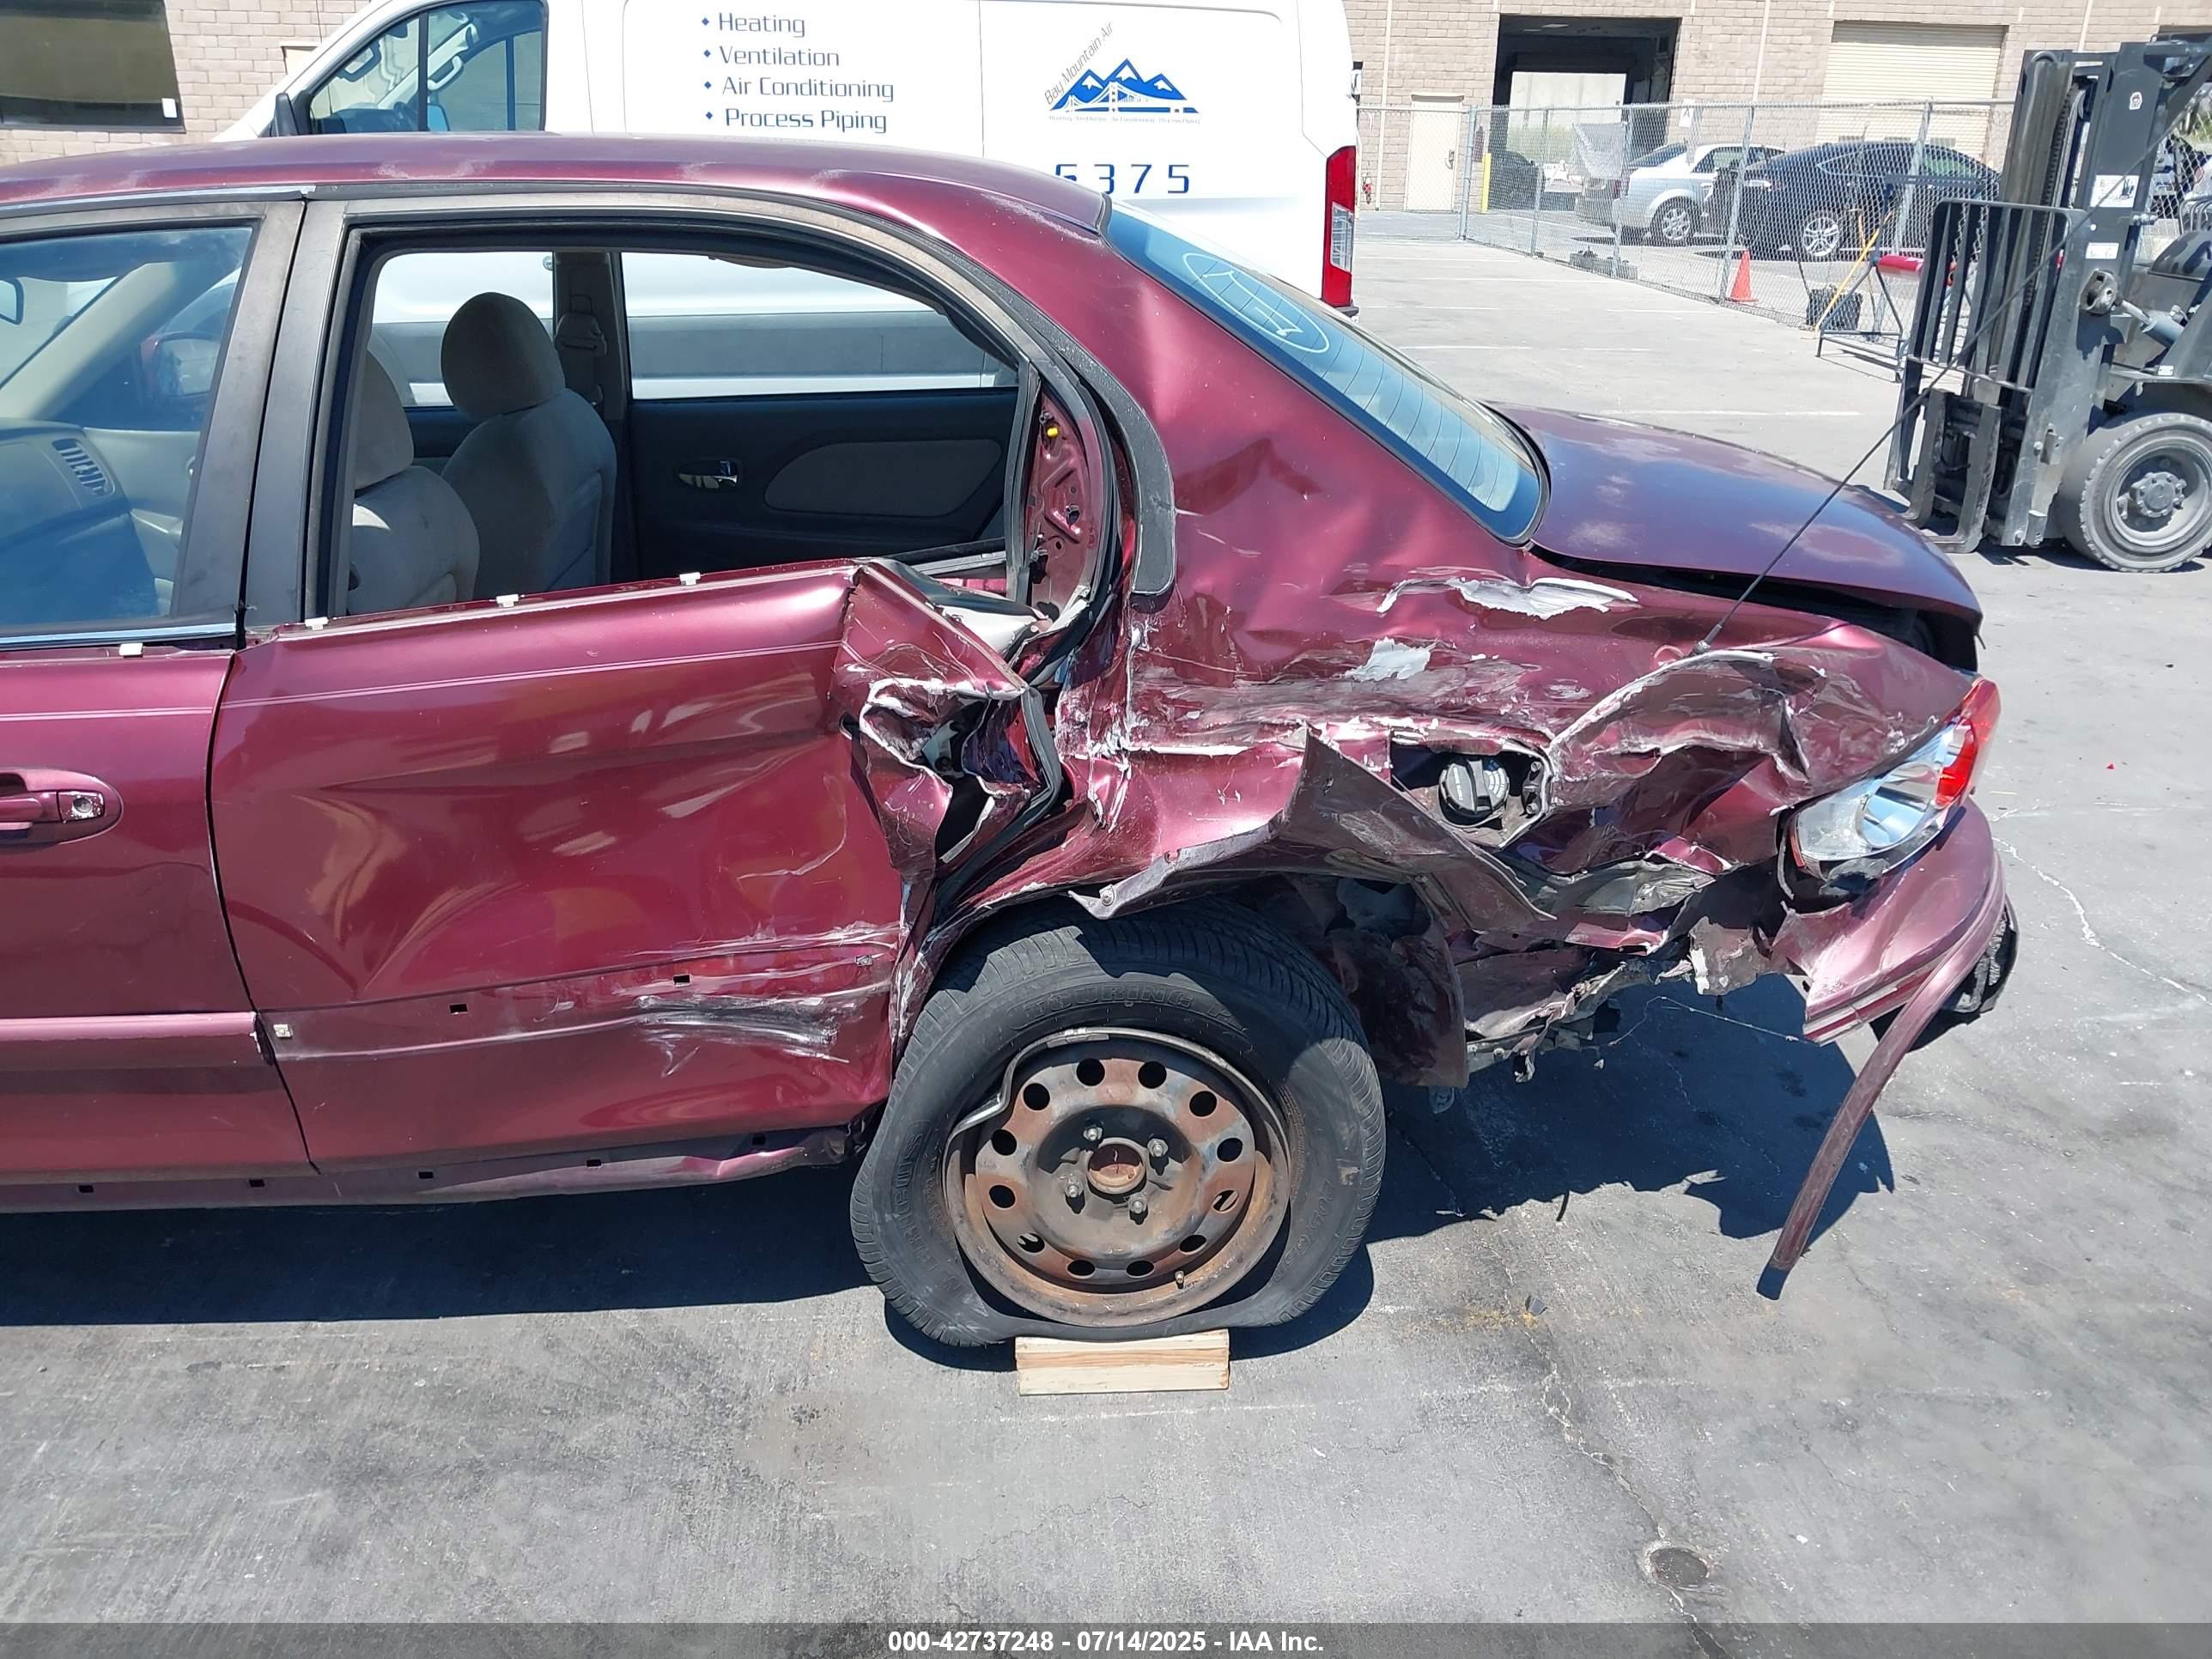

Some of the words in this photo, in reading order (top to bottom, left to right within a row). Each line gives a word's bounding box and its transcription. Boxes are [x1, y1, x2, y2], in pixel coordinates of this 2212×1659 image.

[719, 12, 805, 38] Heating
[719, 46, 840, 67] Ventilation
[1043, 82, 1065, 106] Bay
[1061, 36, 1103, 83] Mountain
[1100, 21, 1114, 41] Air
[722, 76, 752, 95] Air
[759, 76, 894, 102] Conditioning
[726, 108, 814, 128] Process
[821, 110, 887, 134] Piping
